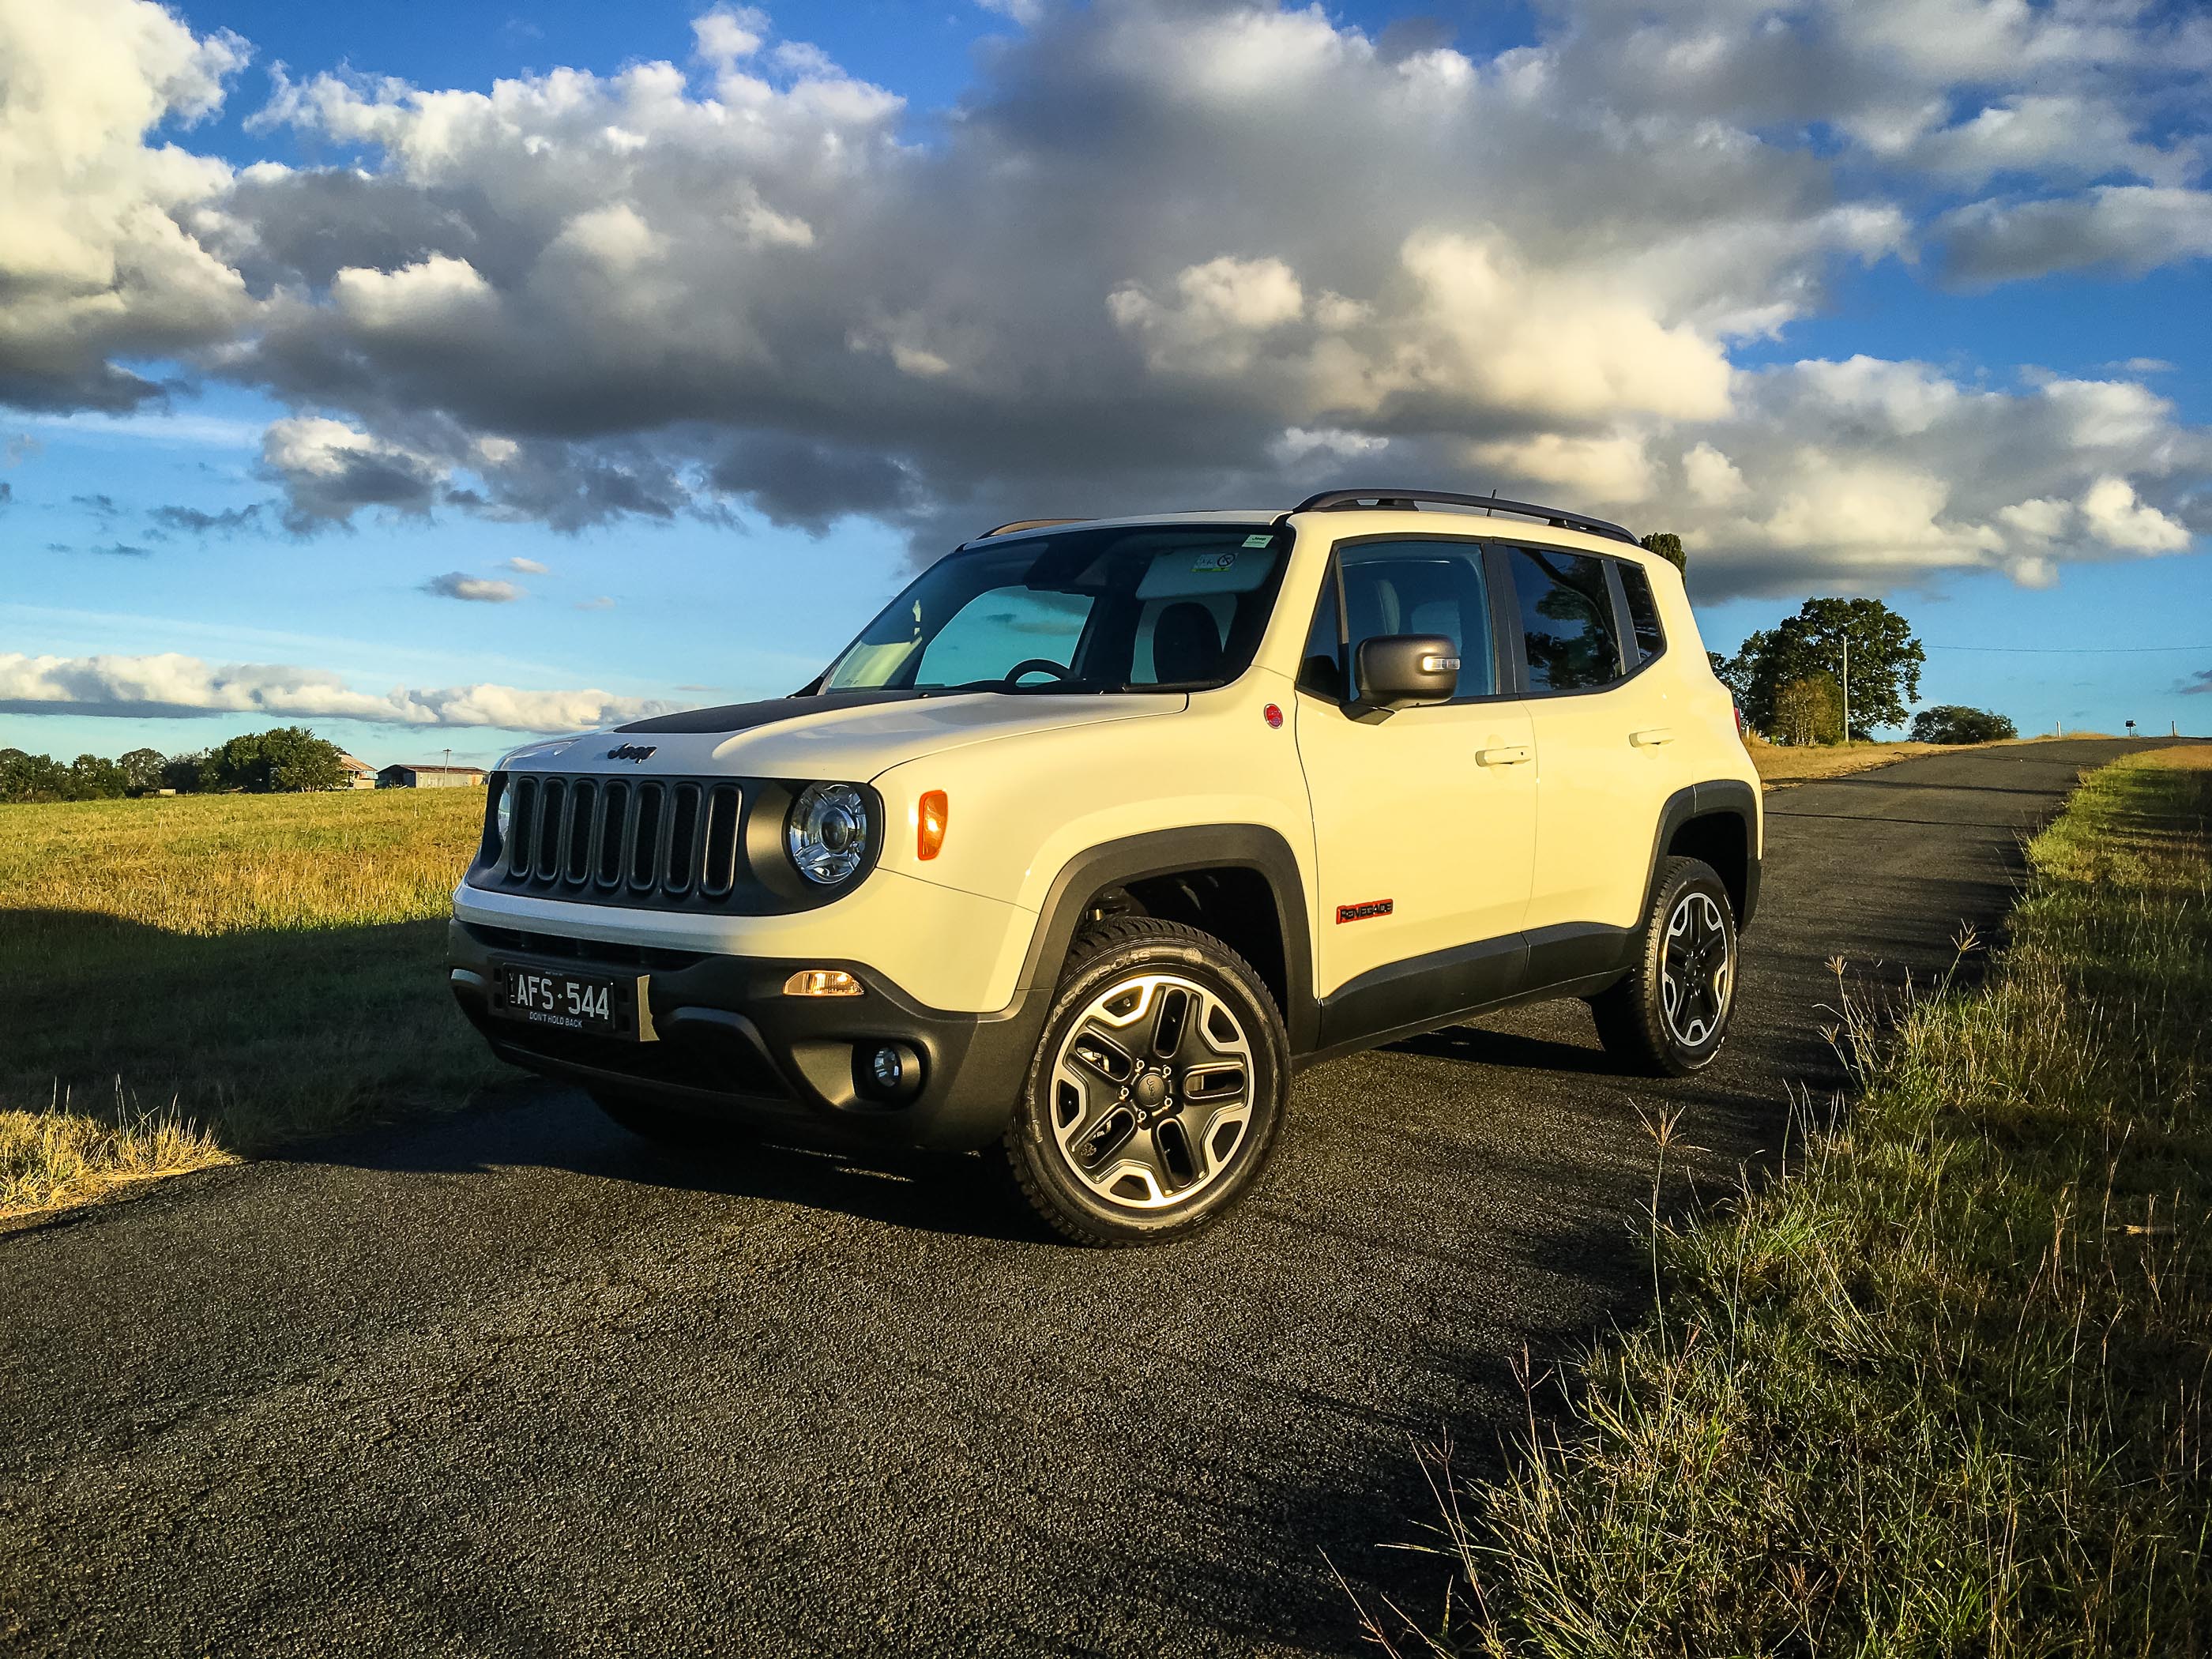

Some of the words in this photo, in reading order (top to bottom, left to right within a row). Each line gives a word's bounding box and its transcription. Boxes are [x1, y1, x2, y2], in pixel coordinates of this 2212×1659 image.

[608, 743, 657, 764] Jeep
[1341, 902, 1392, 920] RENEGADE
[547, 1015, 564, 1025] HOLD
[565, 1018, 582, 1029] BACK
